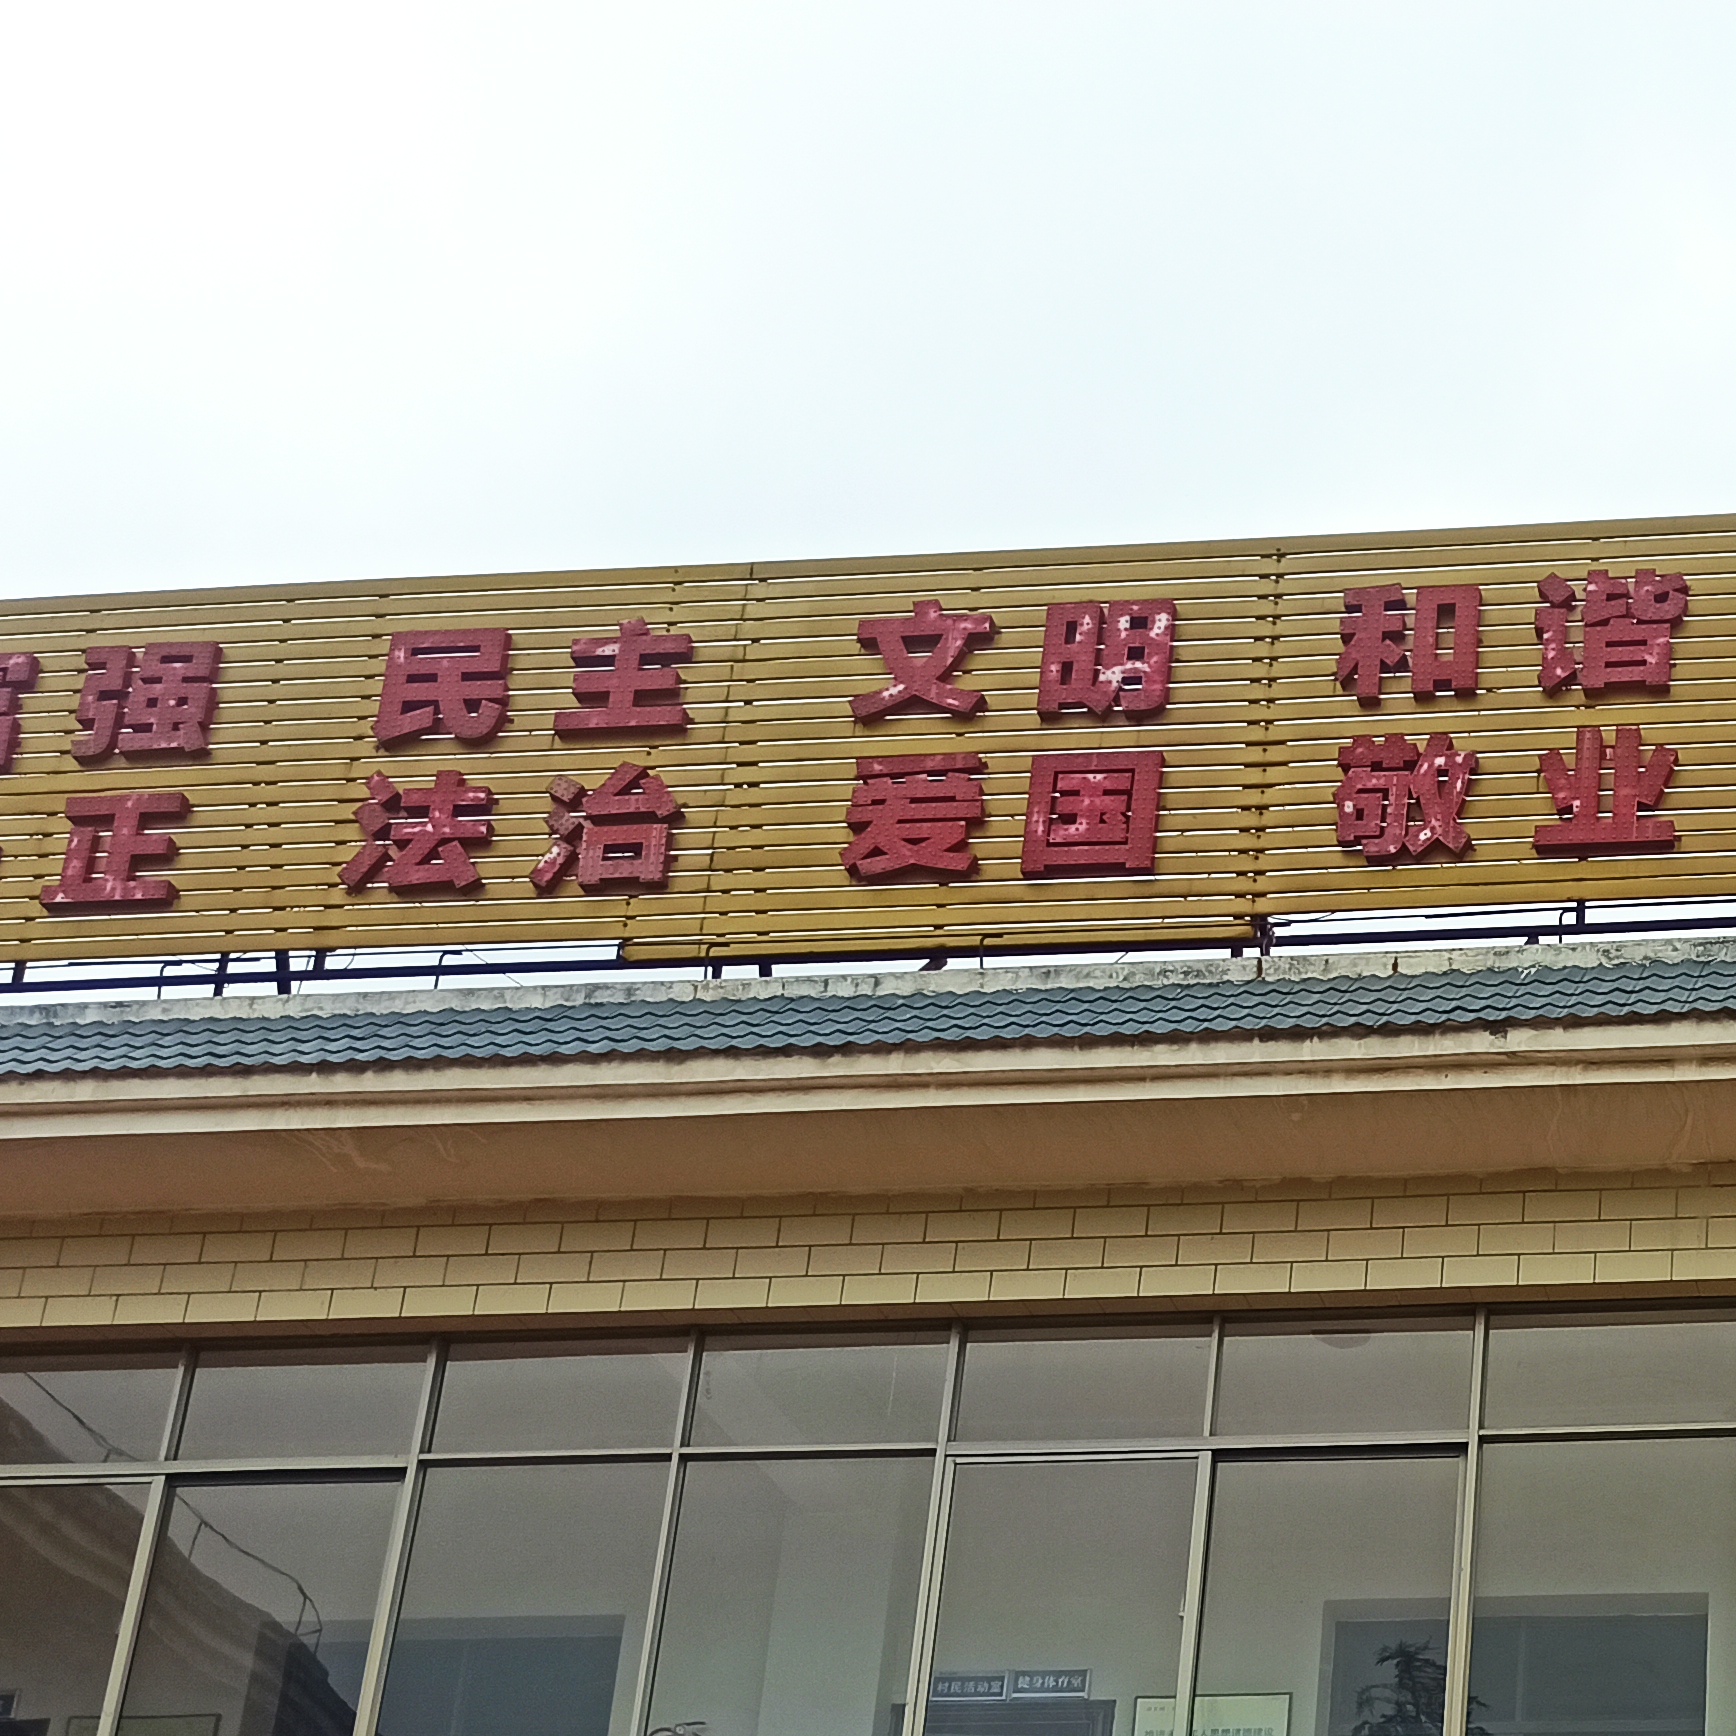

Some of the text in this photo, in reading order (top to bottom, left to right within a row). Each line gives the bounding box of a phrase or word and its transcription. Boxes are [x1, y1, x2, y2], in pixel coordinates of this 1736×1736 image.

[371, 617, 693, 752] 民主
[848, 600, 1177, 726] 文明
[1336, 569, 1689, 707] 和谐
[339, 761, 686, 896] 法治
[839, 752, 1165, 884] 爱国
[1336, 726, 1678, 865] 敬业
[936, 1679, 1003, 1695] 村民活动室
